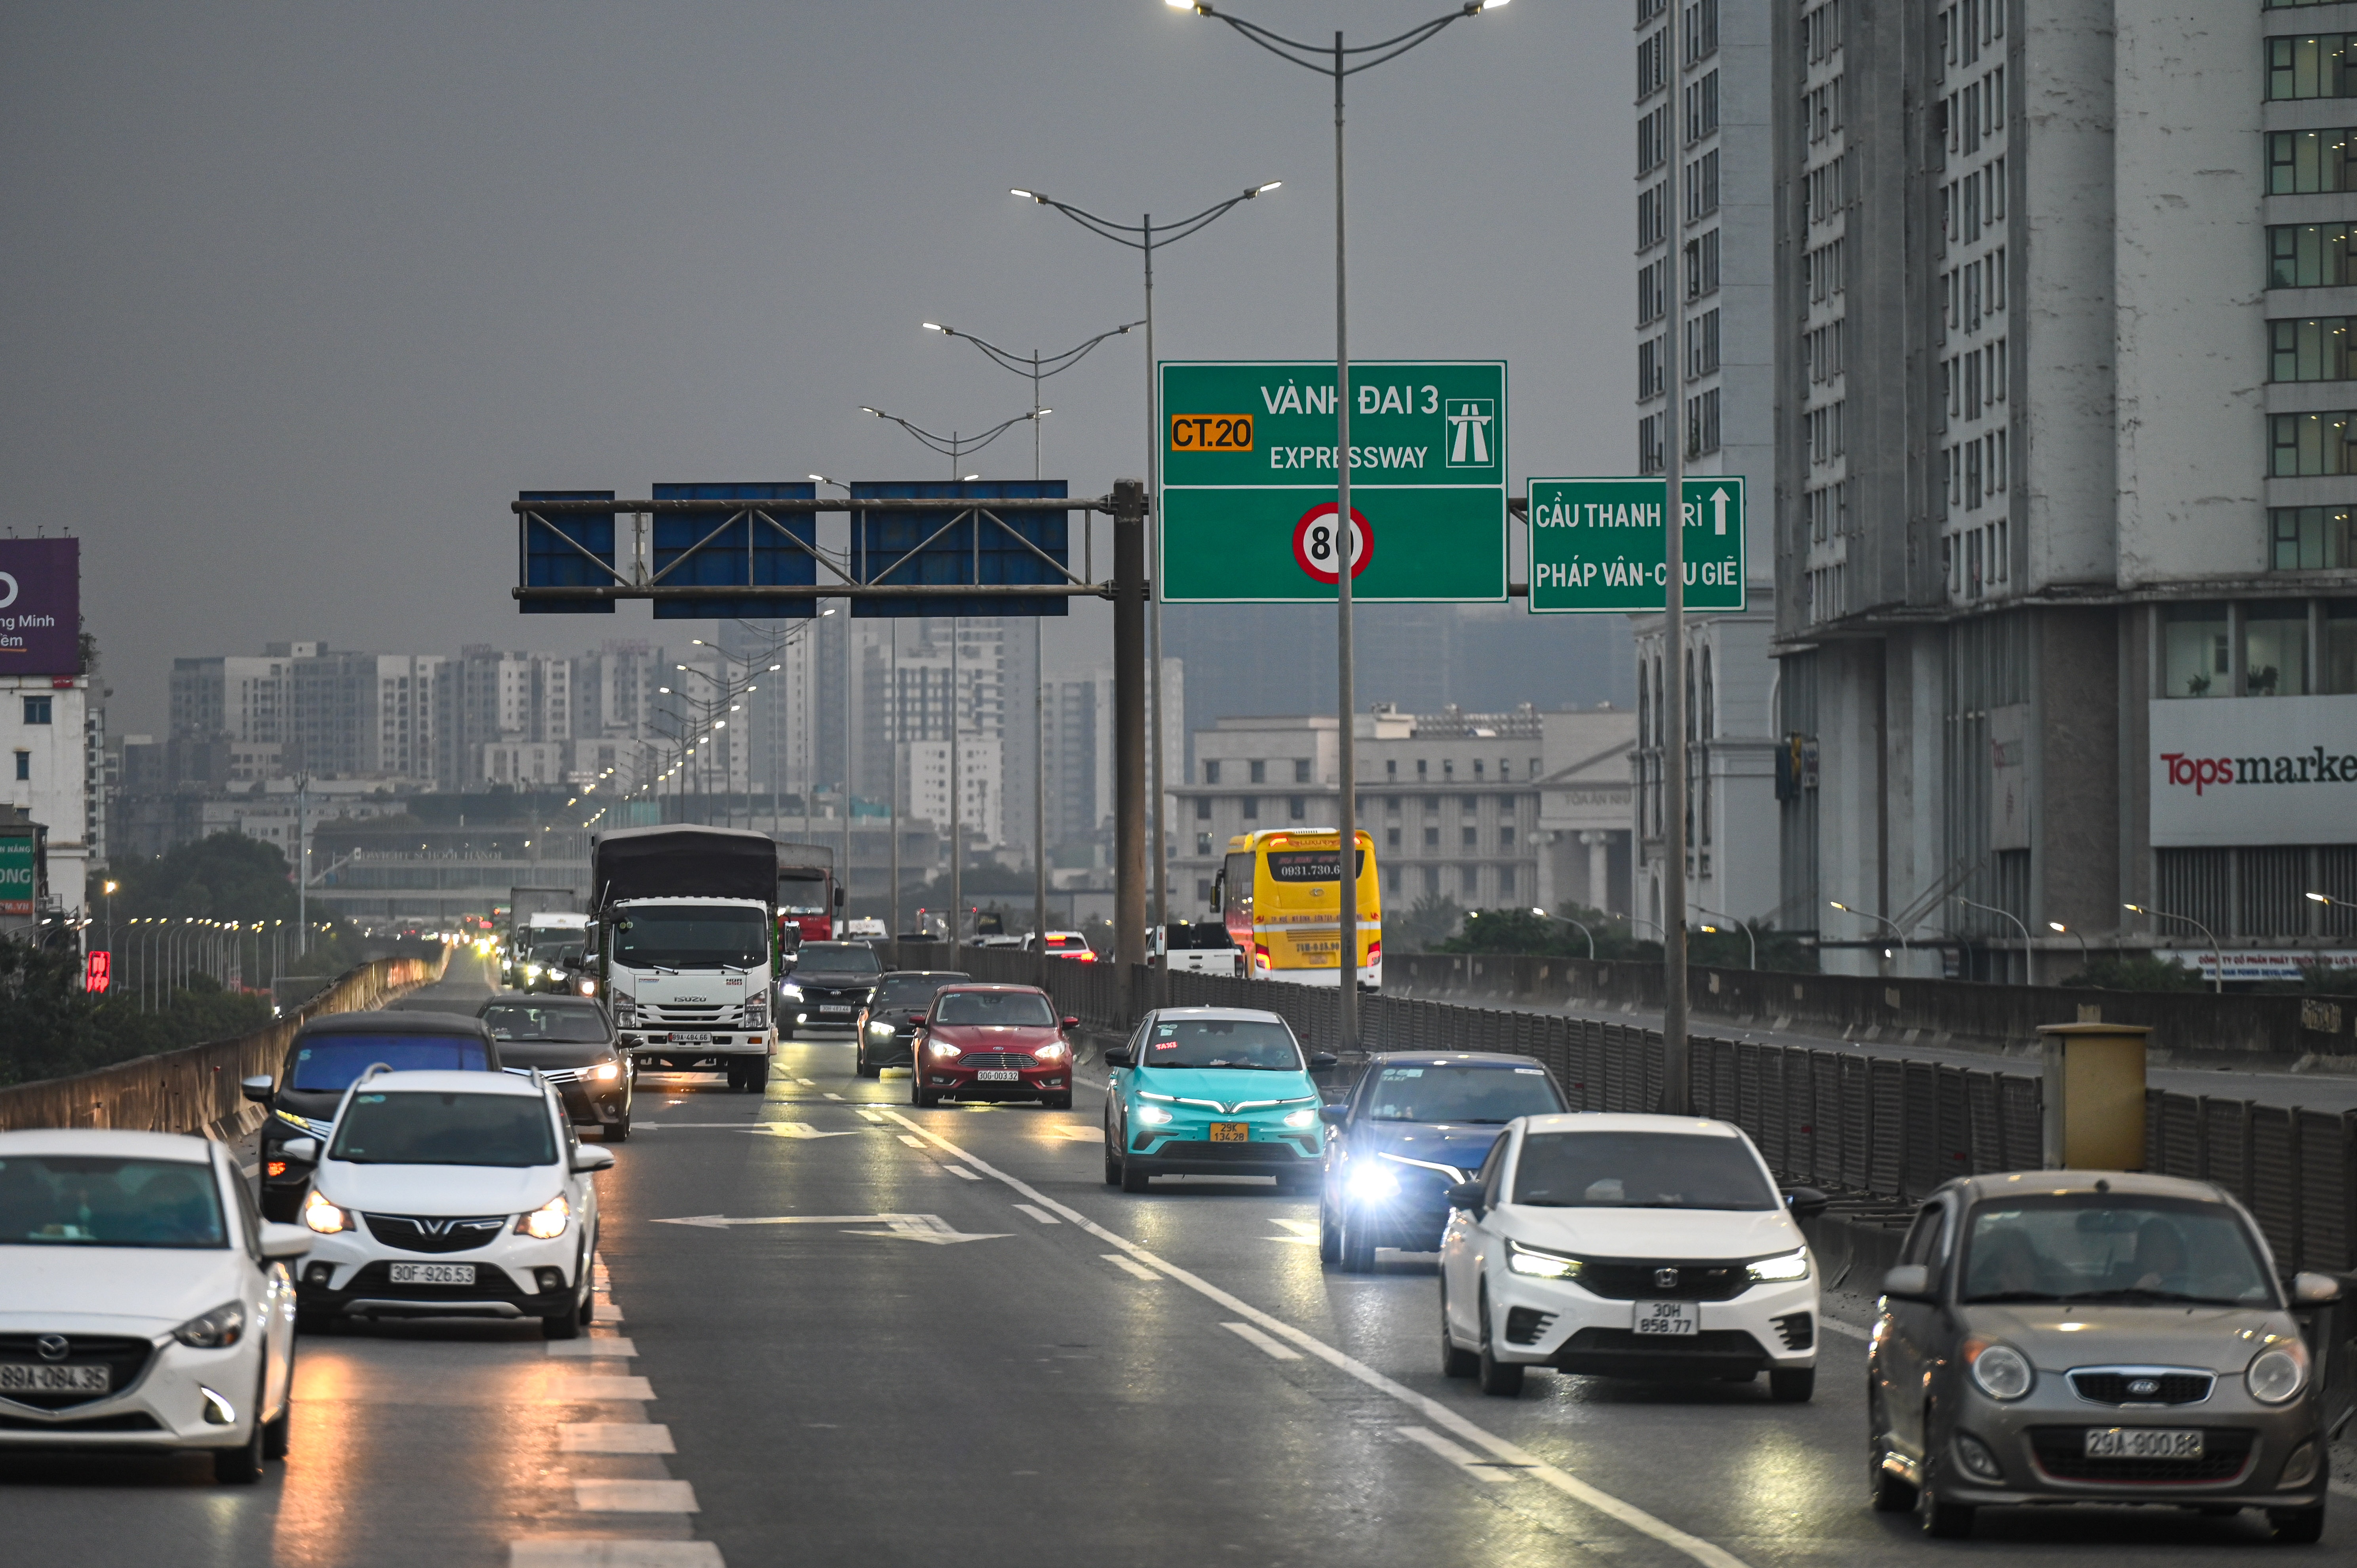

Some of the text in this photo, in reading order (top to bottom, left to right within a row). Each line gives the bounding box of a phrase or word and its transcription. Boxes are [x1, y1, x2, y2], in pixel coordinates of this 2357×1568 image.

[1358, 385, 1411, 414] ĐAI
[1421, 385, 1438, 414] 3
[1172, 419, 1251, 447] CT.20
[1536, 492, 1579, 527] CẦU
[1584, 504, 1661, 527] THANH
[1537, 555, 1737, 587] PHÁP VÂN-CU GIẼ
[19, 615, 55, 627] Minh
[414, 851, 458, 859] SCHOOL
[465, 851, 502, 859] HANOI
[1281, 865, 1340, 876] 0931.730.6
[1155, 1041, 1178, 1050] TAXI
[979, 1072, 1018, 1080] 30G-003.32
[1221, 1123, 1237, 1132] 29K
[394, 1265, 474, 1283] 30F-926.53
[1653, 1303, 1681, 1317] 30H
[1641, 1318, 1692, 1333] 858.77
